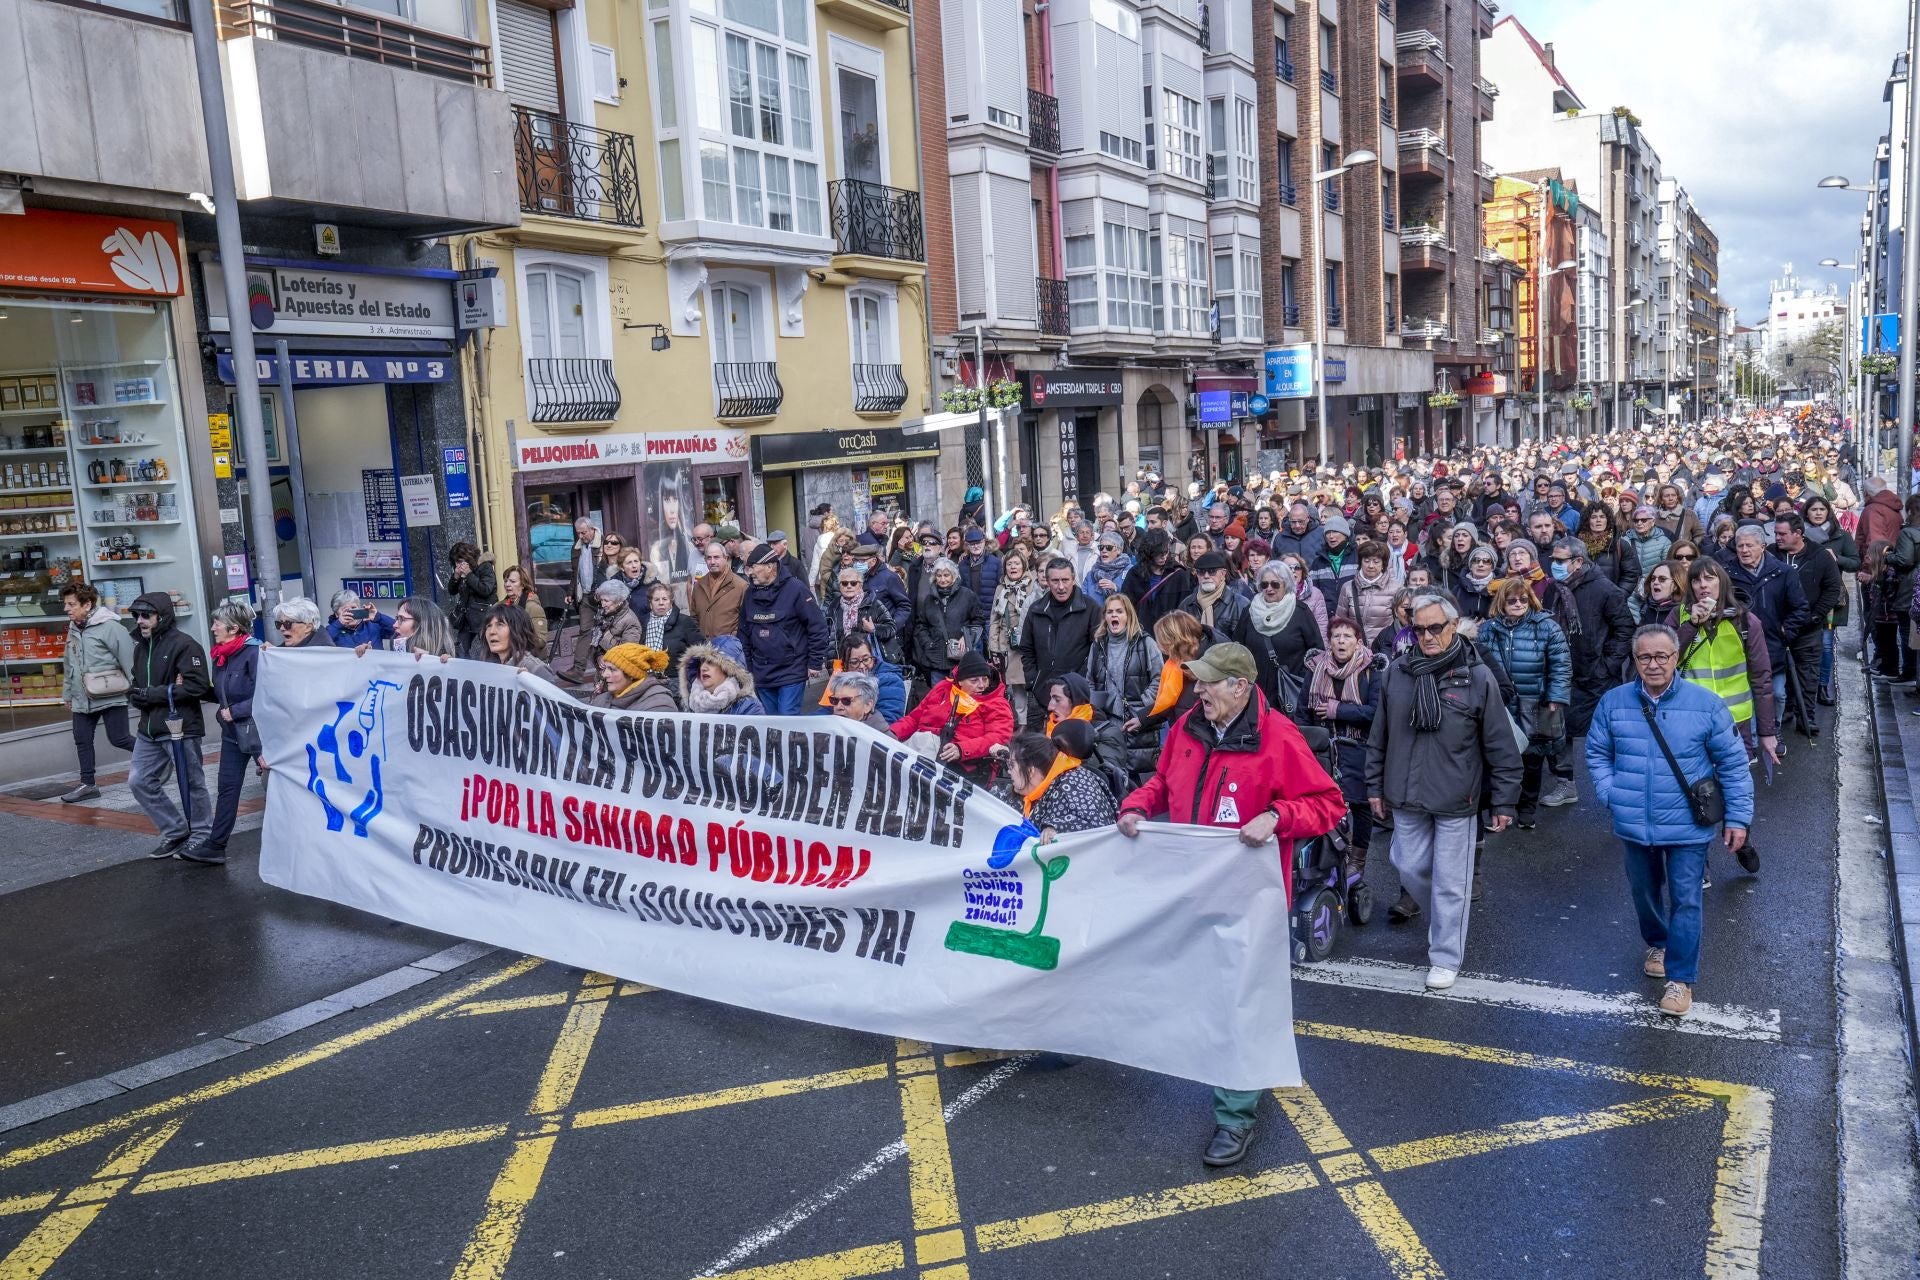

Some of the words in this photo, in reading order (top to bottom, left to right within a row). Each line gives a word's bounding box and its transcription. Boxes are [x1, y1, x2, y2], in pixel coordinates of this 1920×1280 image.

[280, 275, 343, 295] Loterías
[347, 283, 356, 300] y
[285, 297, 354, 317] Apuestas
[359, 300, 380, 317] del
[385, 302, 431, 319] Estado
[370, 325, 375, 334] 3
[377, 325, 387, 335] zk.
[389, 326, 432, 336] Administrazio
[428, 361, 444, 379] 3
[1284, 369, 1292, 378] EN
[1046, 382, 1084, 394] AMSTERDAM
[1085, 382, 1105, 394] TRIPLE
[1110, 382, 1122, 394] CBD
[522, 439, 599, 464] PELUQUERÍA
[647, 435, 717, 455] PINTAUÑAS
[402, 477, 424, 487] LOTERIA
[407, 674, 616, 790] OSASUNGINTZA
[616, 715, 857, 830] PUBLIKOAREN
[855, 741, 973, 848] ALDE!
[461, 774, 520, 829] ¡POR
[526, 788, 557, 839] LA
[563, 795, 698, 867] SANIDAD
[707, 820, 871, 889] PÚBLICA!
[963, 868, 1018, 879] Osasun
[413, 823, 583, 903] PROMESARIK
[582, 866, 628, 913] EZ!
[629, 881, 848, 953] ¡SOLUCIONES
[854, 906, 915, 966] YA!
[964, 879, 1022, 896] publikoa
[964, 891, 1001, 907] landu
[1002, 896, 1023, 909] eta
